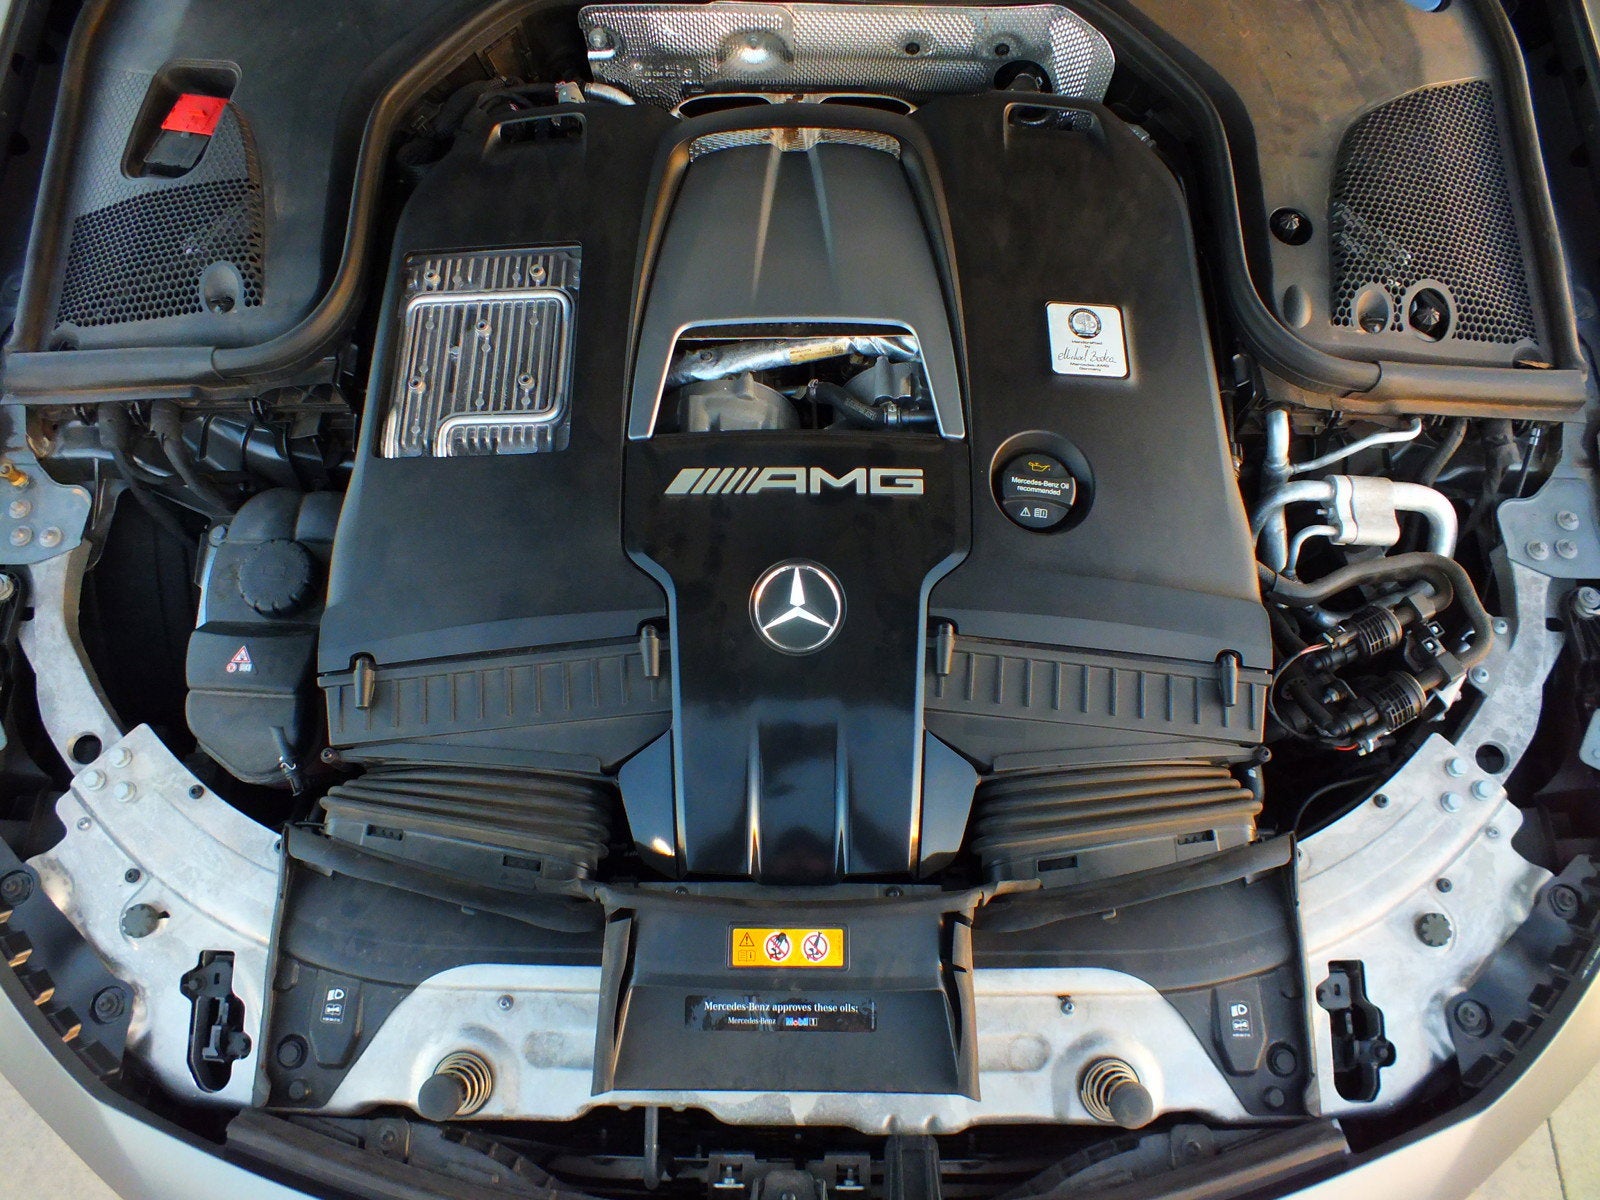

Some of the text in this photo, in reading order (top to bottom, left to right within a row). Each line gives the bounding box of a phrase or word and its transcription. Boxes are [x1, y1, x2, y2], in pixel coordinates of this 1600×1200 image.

[746, 467, 924, 494] AMG
[1011, 476, 1060, 489] Mercedes-Benz
[1016, 485, 1061, 496] recommended
[704, 1001, 859, 1014] Mercedes-Benz approves these oils:
[727, 1016, 777, 1025] Mercedes-Benz
